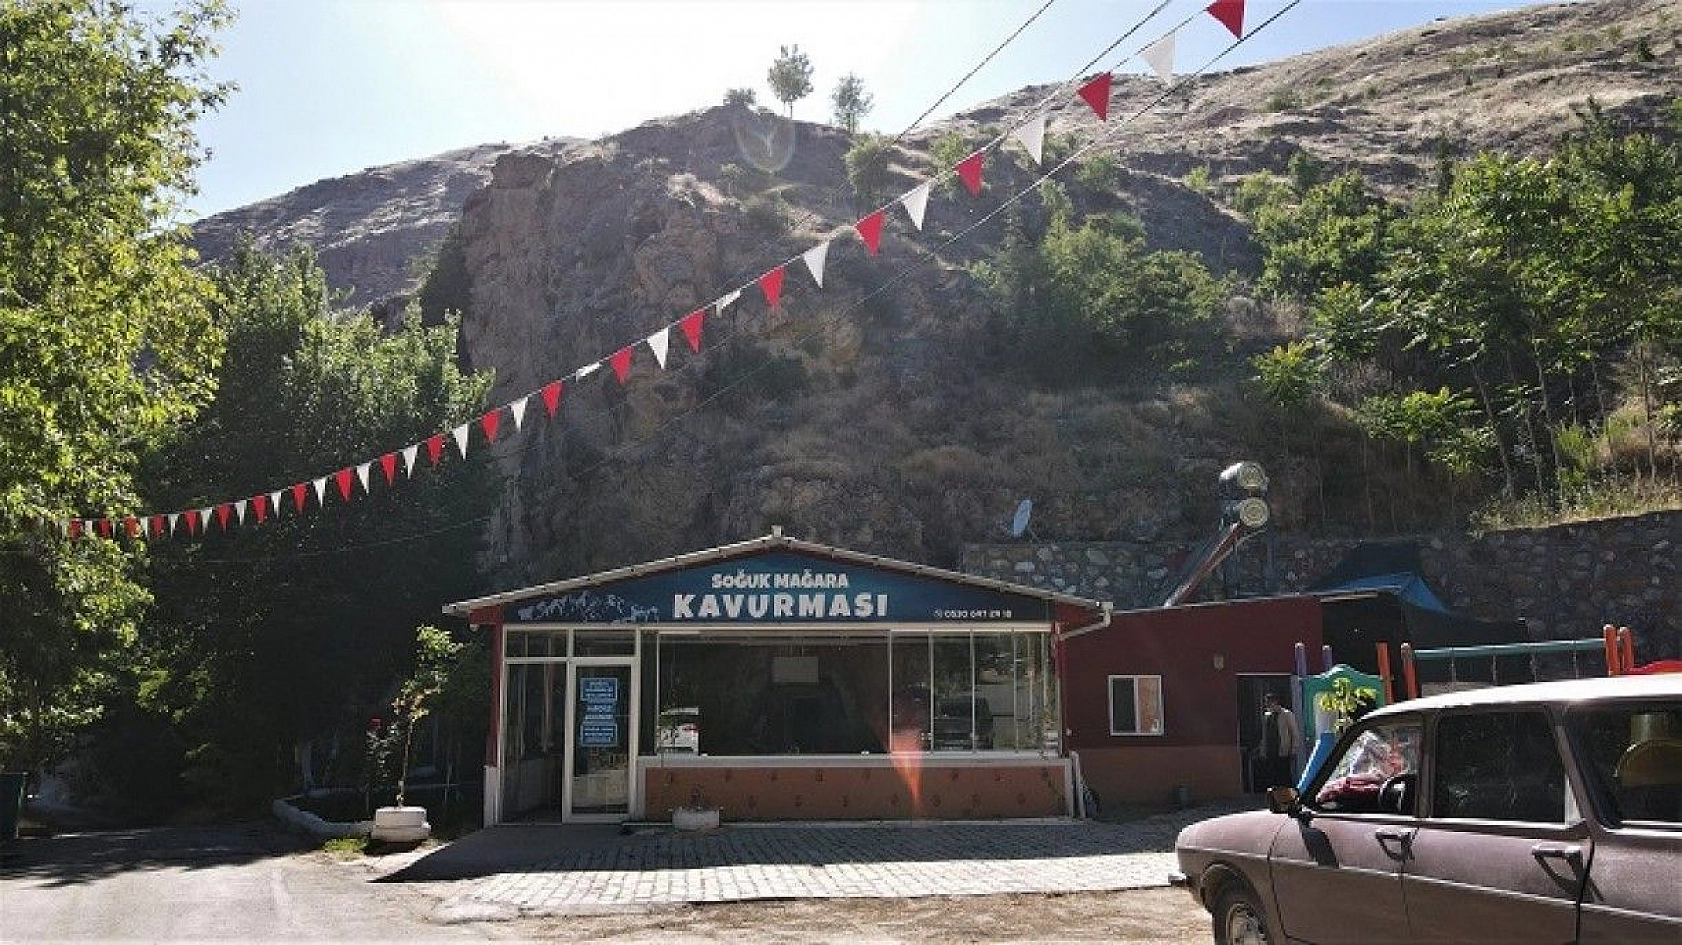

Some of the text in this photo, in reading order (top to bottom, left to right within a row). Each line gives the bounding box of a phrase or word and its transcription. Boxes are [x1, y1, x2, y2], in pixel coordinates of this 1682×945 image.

[711, 569, 849, 588] SOĞUK MAĞARA
[674, 594, 888, 618] KAVURMASI
